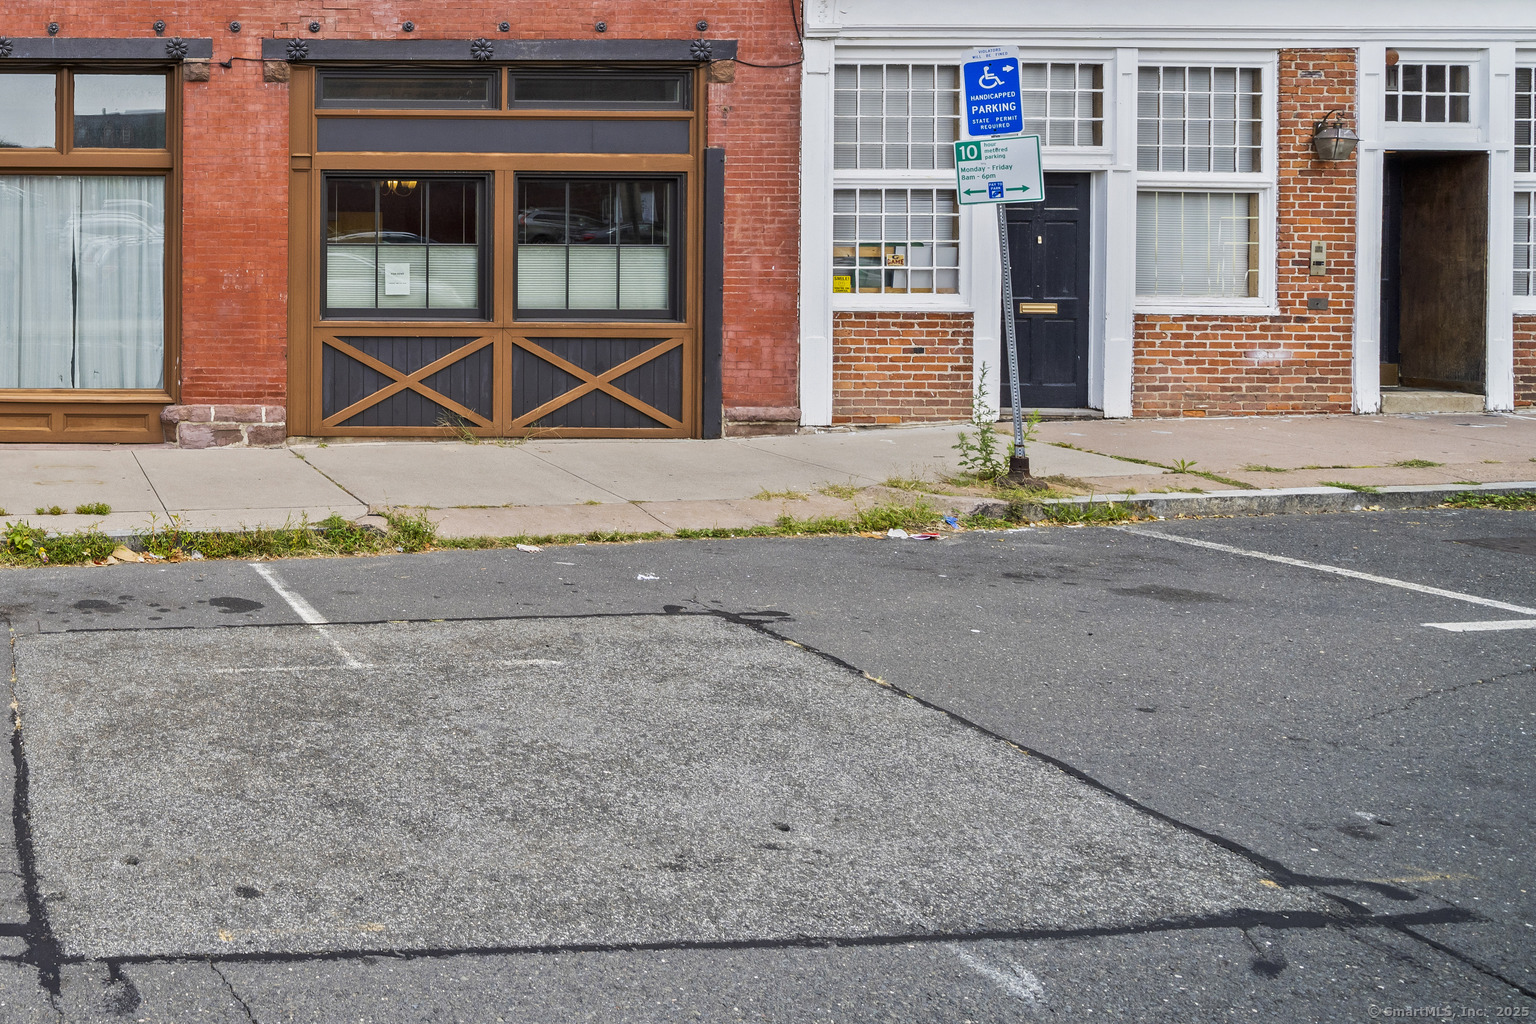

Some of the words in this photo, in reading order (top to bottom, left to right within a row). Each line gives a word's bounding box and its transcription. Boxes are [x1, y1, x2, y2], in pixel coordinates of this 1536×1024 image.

[970, 91, 1016, 101] HANDICAPPED
[971, 102, 1016, 115] PARKING
[980, 122, 1010, 130] REQUIRED
[959, 144, 978, 160] 10
